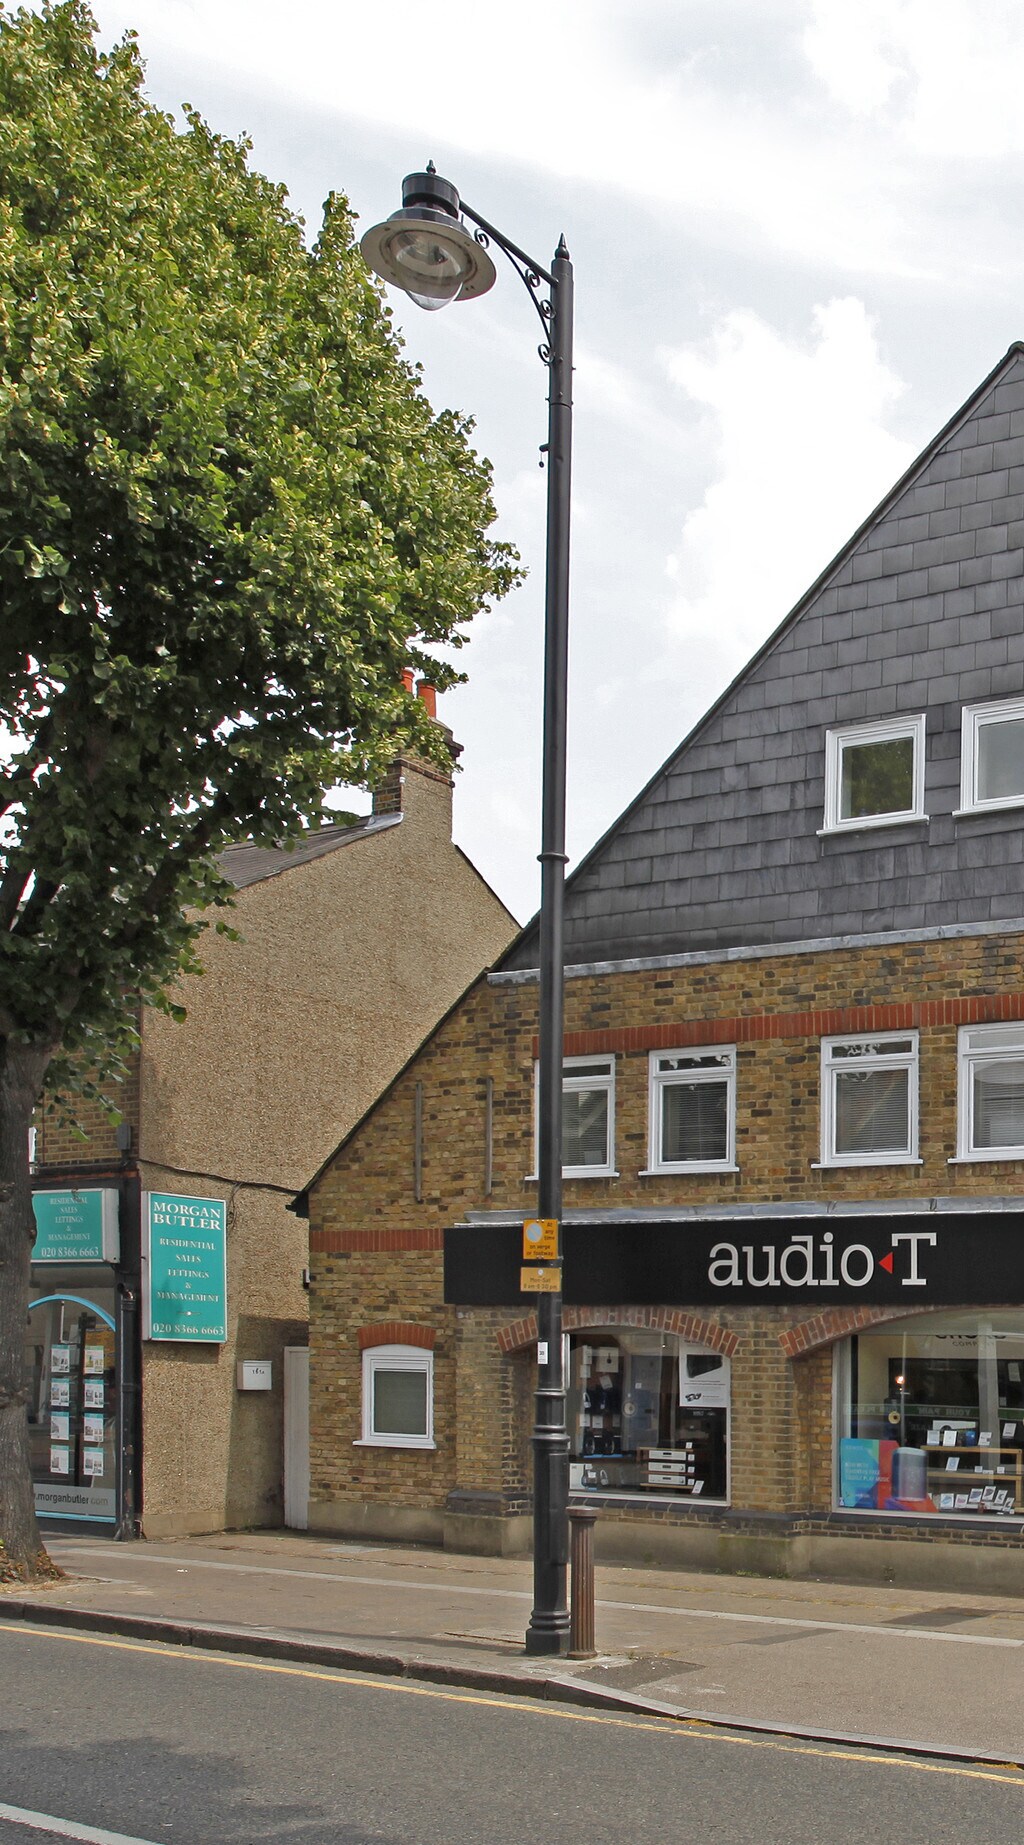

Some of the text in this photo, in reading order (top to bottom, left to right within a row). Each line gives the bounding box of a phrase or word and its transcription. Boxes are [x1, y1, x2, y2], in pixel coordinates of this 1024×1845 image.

[60, 1206, 78, 1214] SALES
[153, 1201, 221, 1219] MORGAN
[55, 1216, 84, 1224] LETTINGS
[153, 1213, 222, 1231] BUTLER
[47, 1233, 91, 1241] MANAGEMENT
[159, 1237, 217, 1250] RESIDENTIAL
[40, 1246, 99, 1258] 020 8366 6663
[175, 1254, 202, 1263] SALES
[707, 1231, 937, 1288] audio T
[167, 1268, 210, 1278] LETTINGS
[184, 1281, 193, 1289] &
[157, 1291, 219, 1303] MANAGEMENT
[152, 1323, 224, 1336] 020 8366 6663
